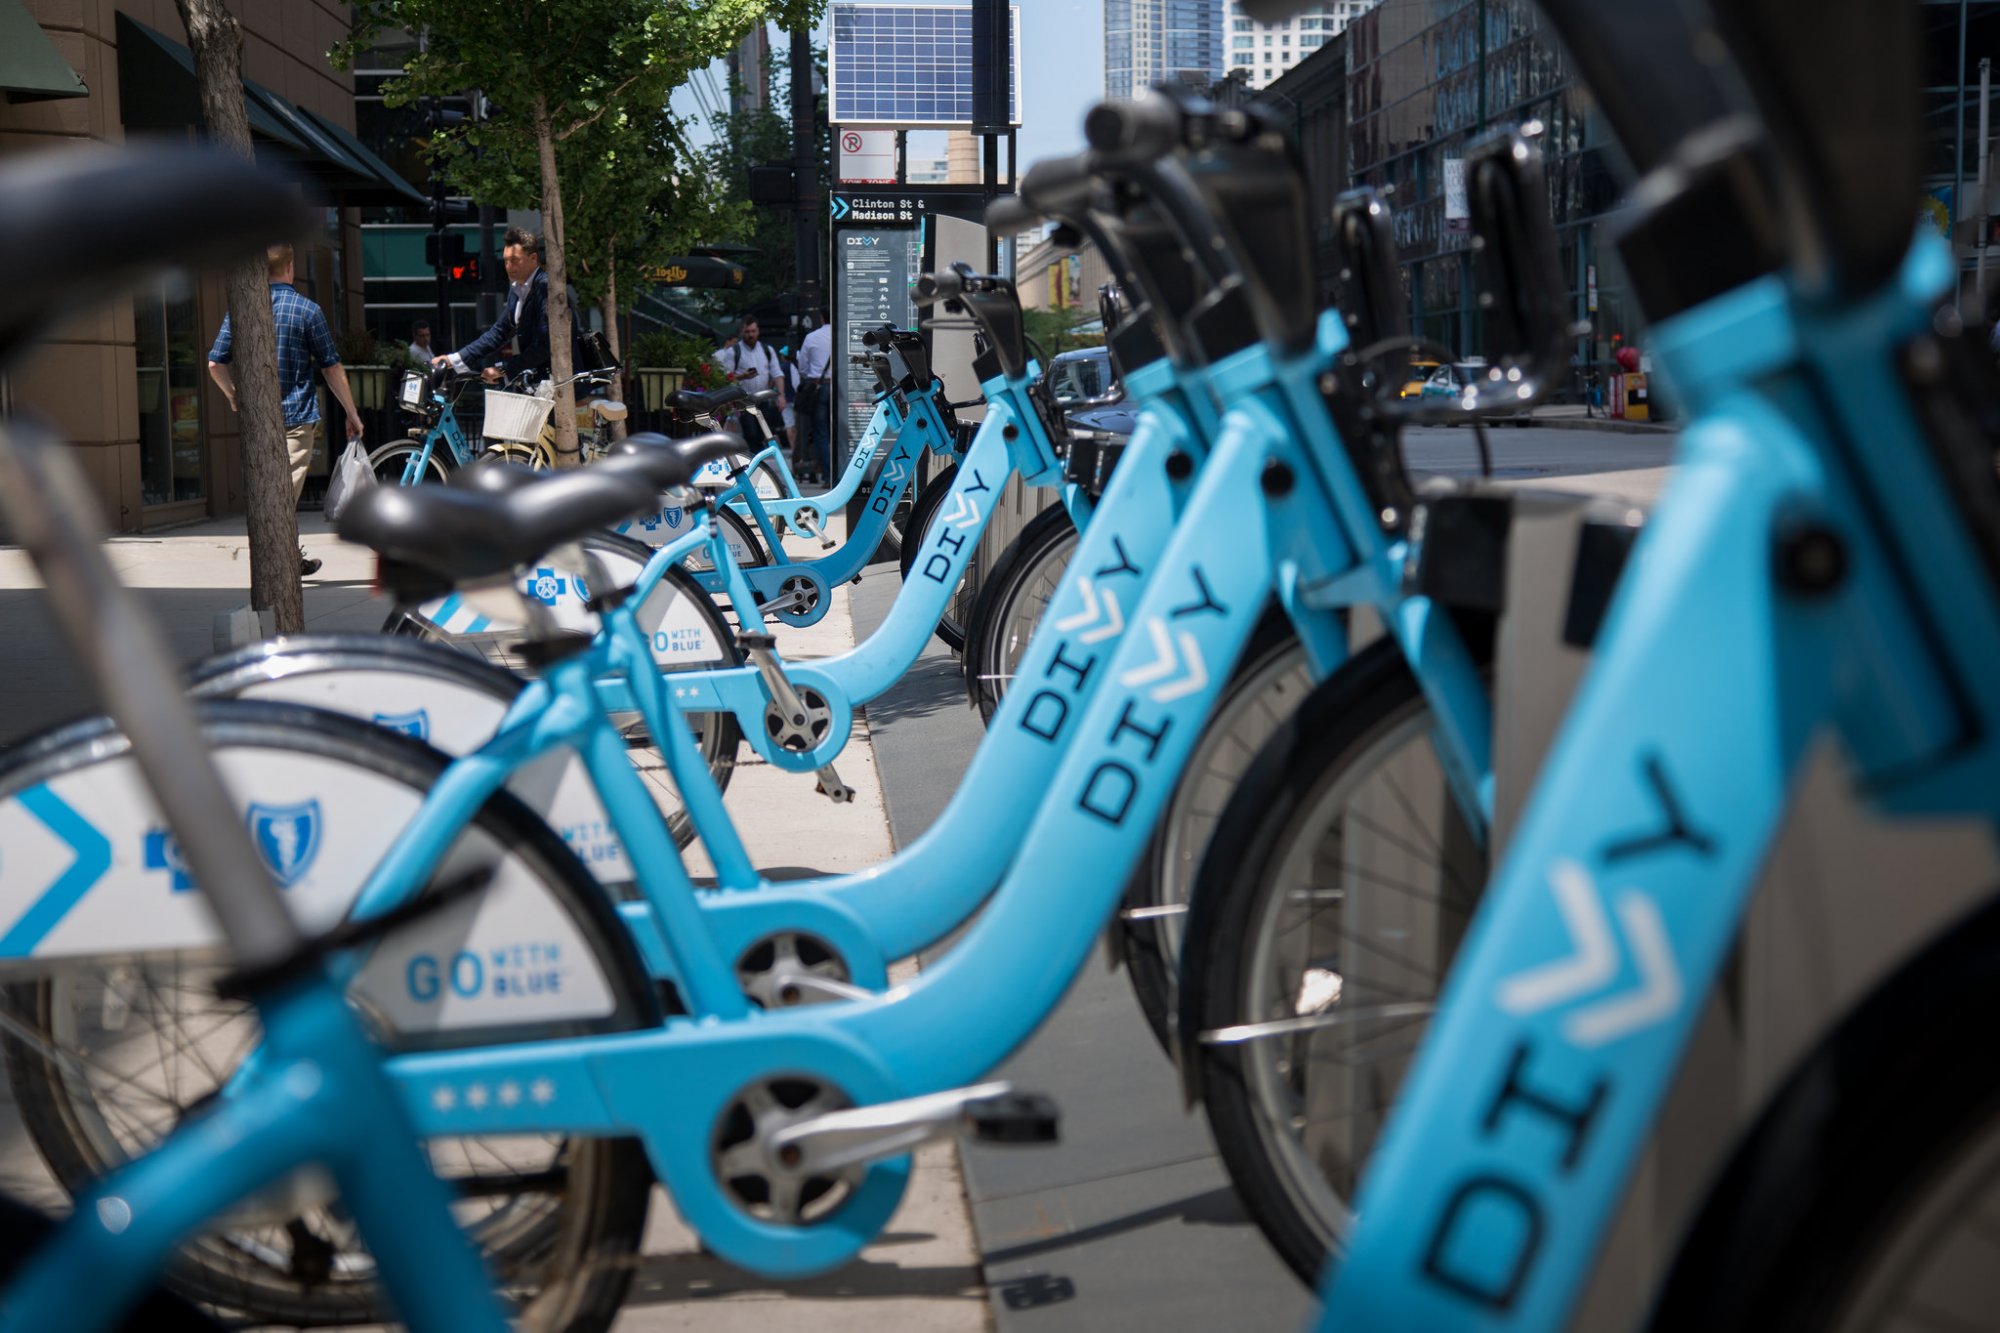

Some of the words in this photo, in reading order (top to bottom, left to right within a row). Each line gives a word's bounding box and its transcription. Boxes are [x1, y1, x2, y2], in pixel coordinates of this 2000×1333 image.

[852, 198, 895, 208] Clinton
[900, 199, 913, 209] St
[918, 200, 924, 209] &
[852, 210, 895, 220] Madison
[900, 211, 913, 220] St
[671, 628, 701, 640] WITH
[672, 640, 702, 652] BLUE
[406, 950, 485, 1003] GO
[490, 943, 561, 968] WITH
[493, 971, 562, 998] BLUE
